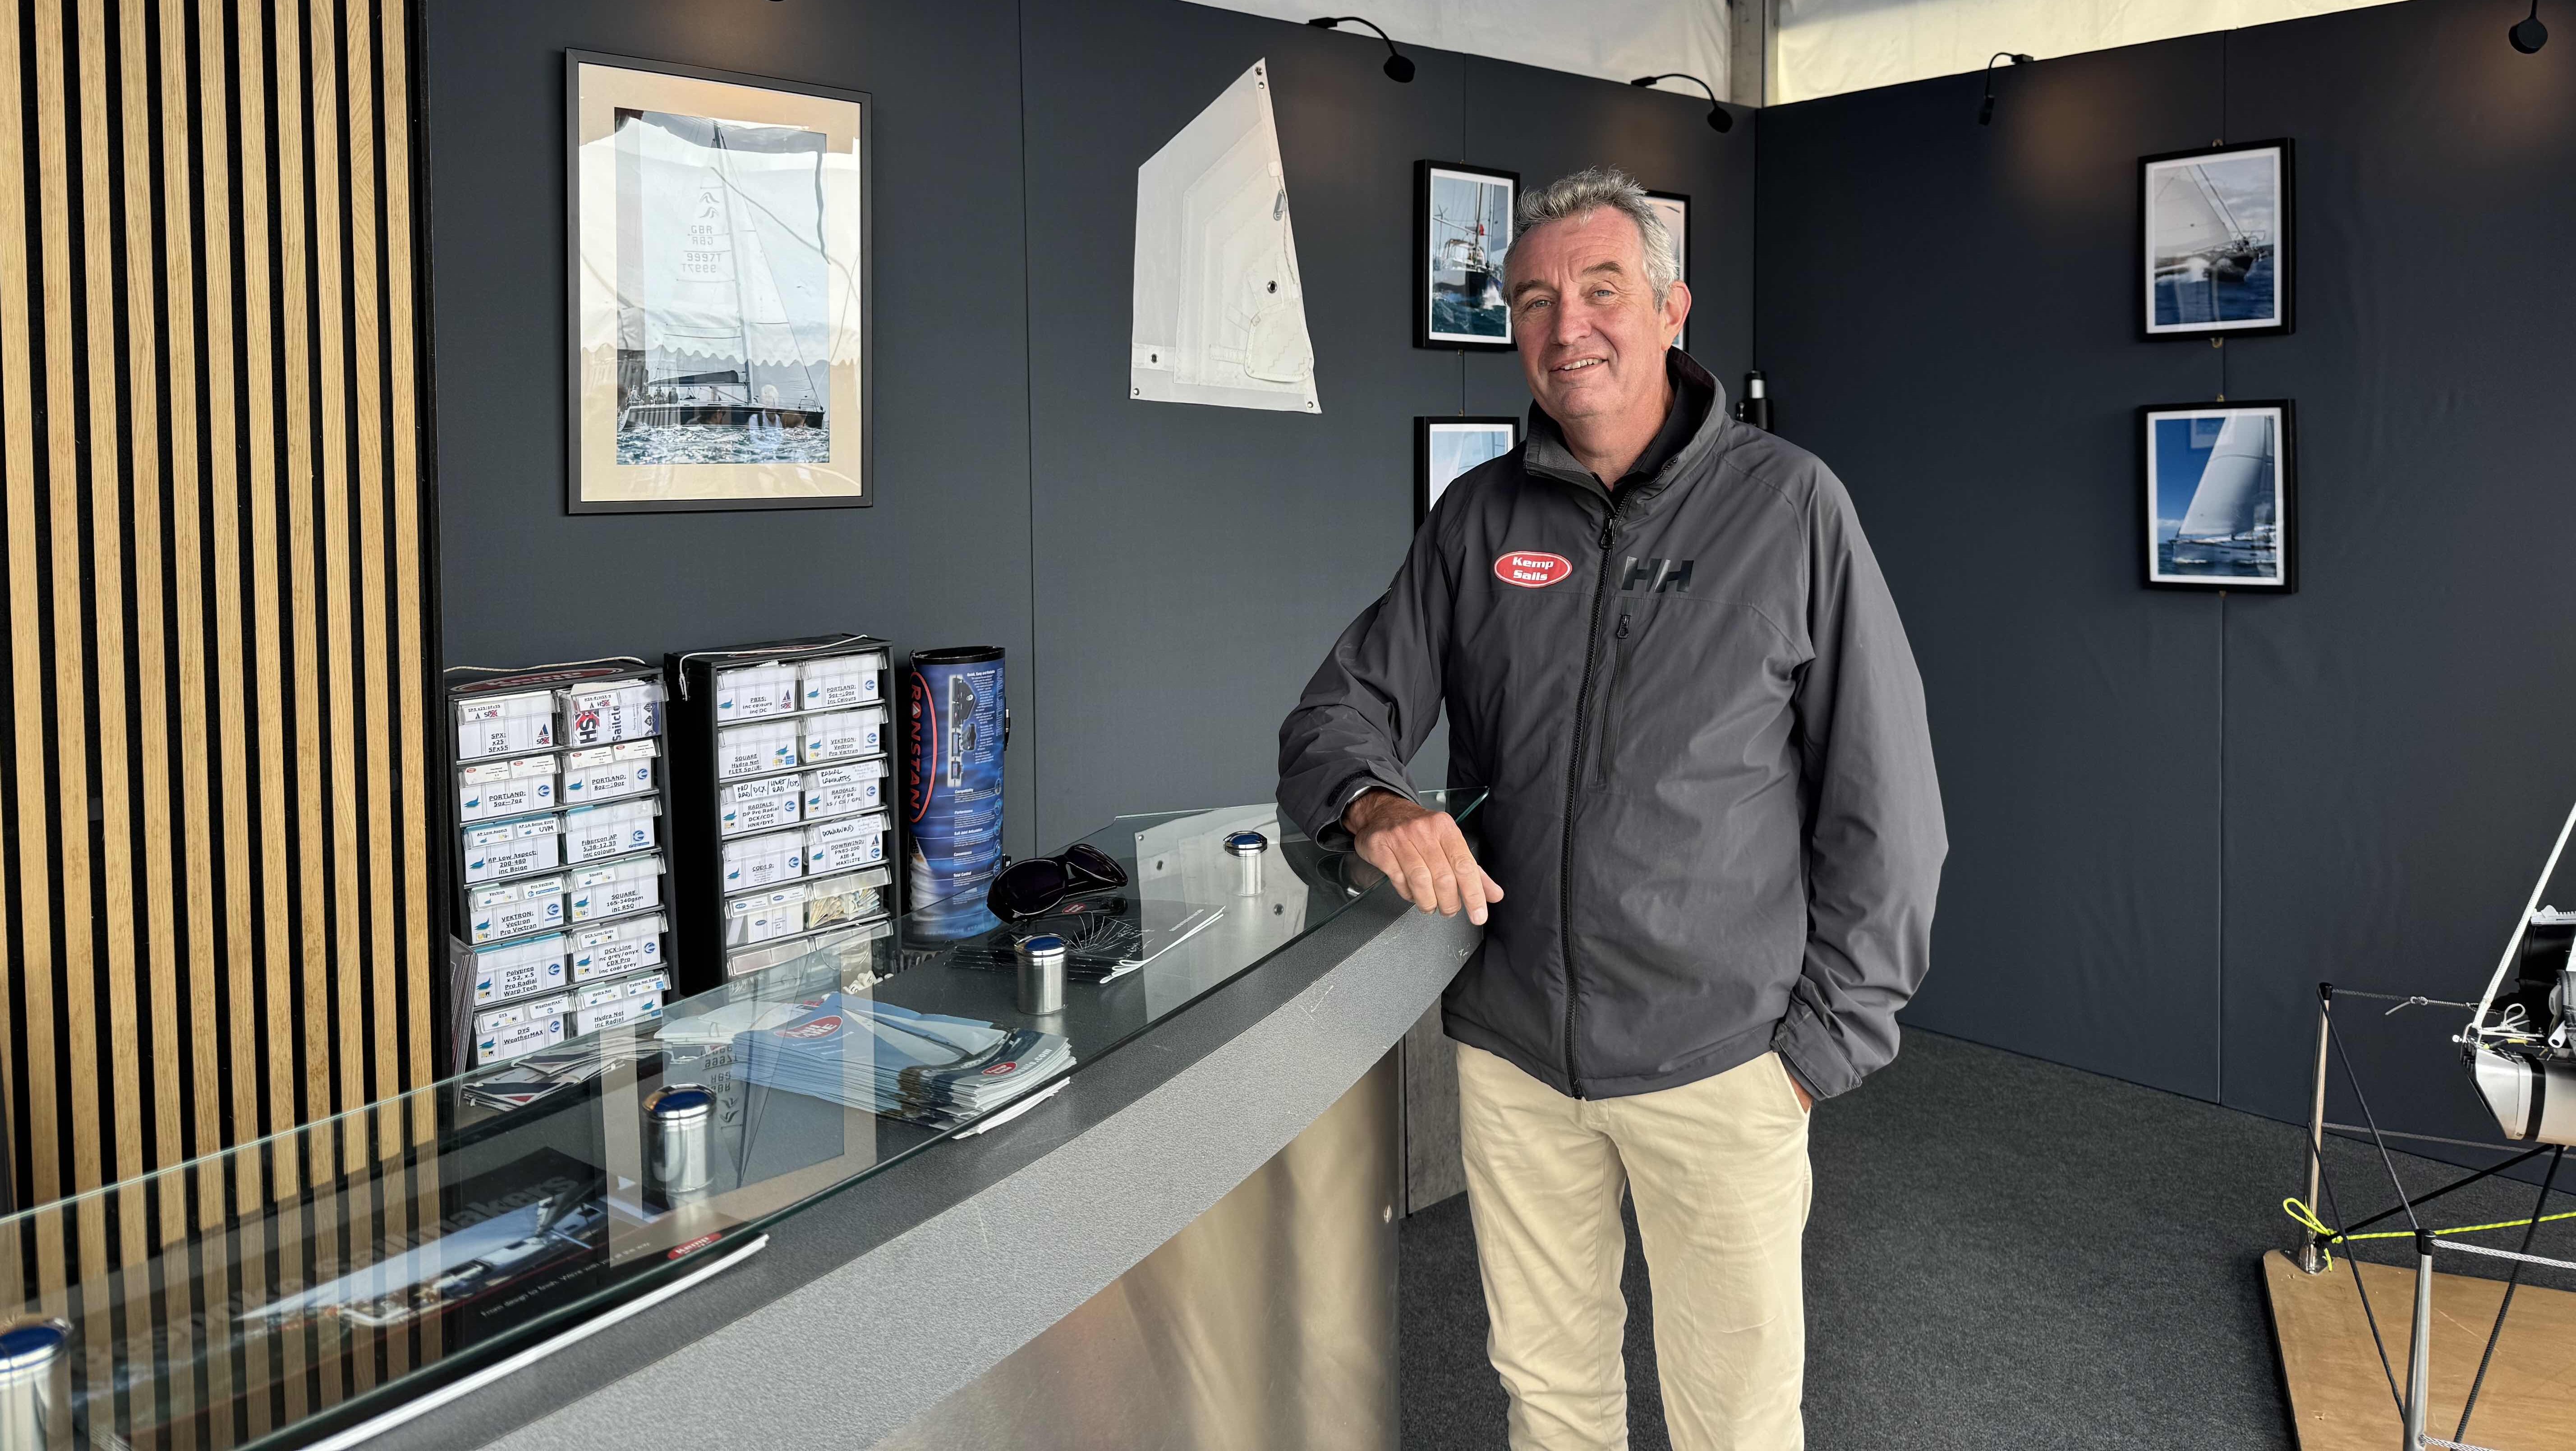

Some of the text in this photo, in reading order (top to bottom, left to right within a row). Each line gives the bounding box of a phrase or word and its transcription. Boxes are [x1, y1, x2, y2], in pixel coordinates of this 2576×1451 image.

[691, 225, 713, 234] GBR
[1512, 556, 1554, 569] Kemp
[1513, 570, 1548, 581] Sails
[910, 684, 922, 809] RONSTAN
[489, 791, 526, 801] PORTLAND:
[748, 802, 774, 810] RADIALS:
[594, 848, 616, 856] colours
[608, 949, 639, 960] grey/onyx
[518, 978, 537, 987] Radial
[594, 1014, 613, 1023] Hydra
[503, 1030, 543, 1045] WeatherMAX
